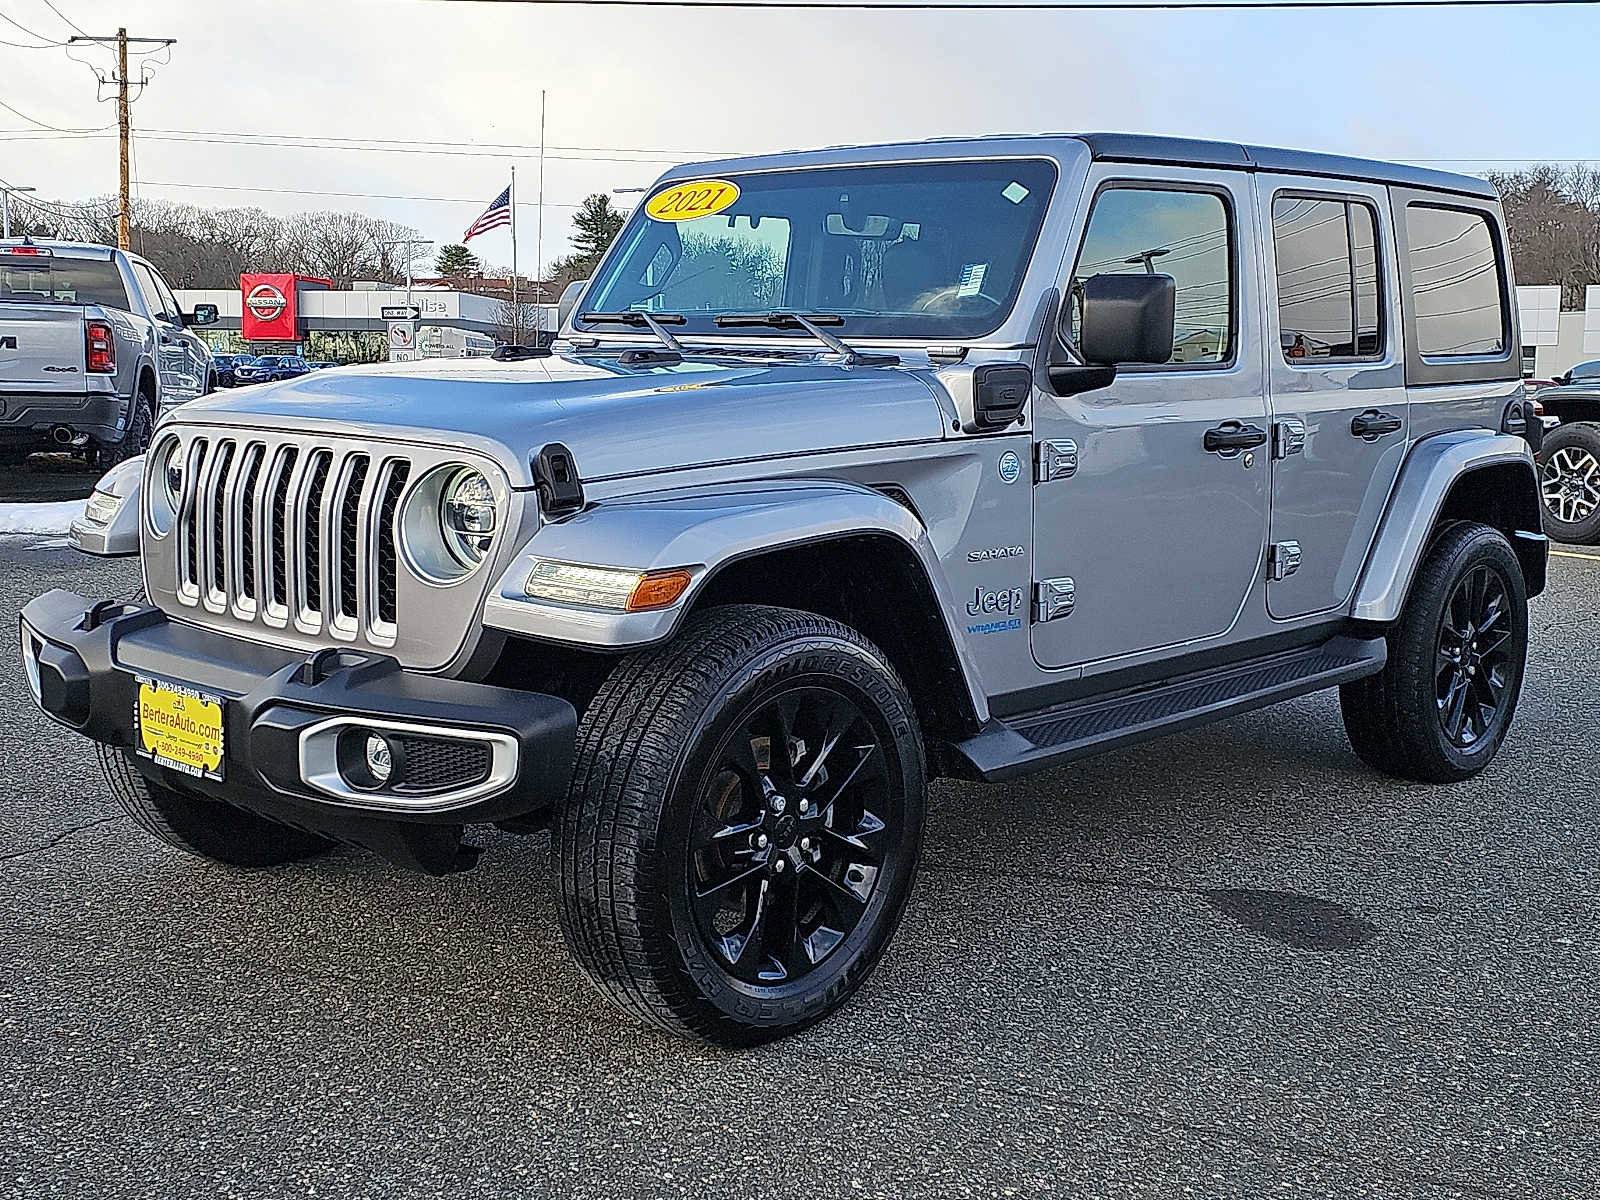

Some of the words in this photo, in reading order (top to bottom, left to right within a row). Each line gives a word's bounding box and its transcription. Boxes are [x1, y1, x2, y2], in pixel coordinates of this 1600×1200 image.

[656, 187, 728, 214] 2021
[248, 299, 282, 307] NISSAN
[396, 353, 409, 361] NO
[967, 545, 1025, 562] SAHARA
[966, 587, 1023, 616] Jeep
[967, 618, 1022, 634] WRANGLER
[752, 656, 908, 738] BRIDGESTONE
[142, 702, 220, 741] BerteraAuto.com
[155, 740, 204, 763] 1-800-249-4980
